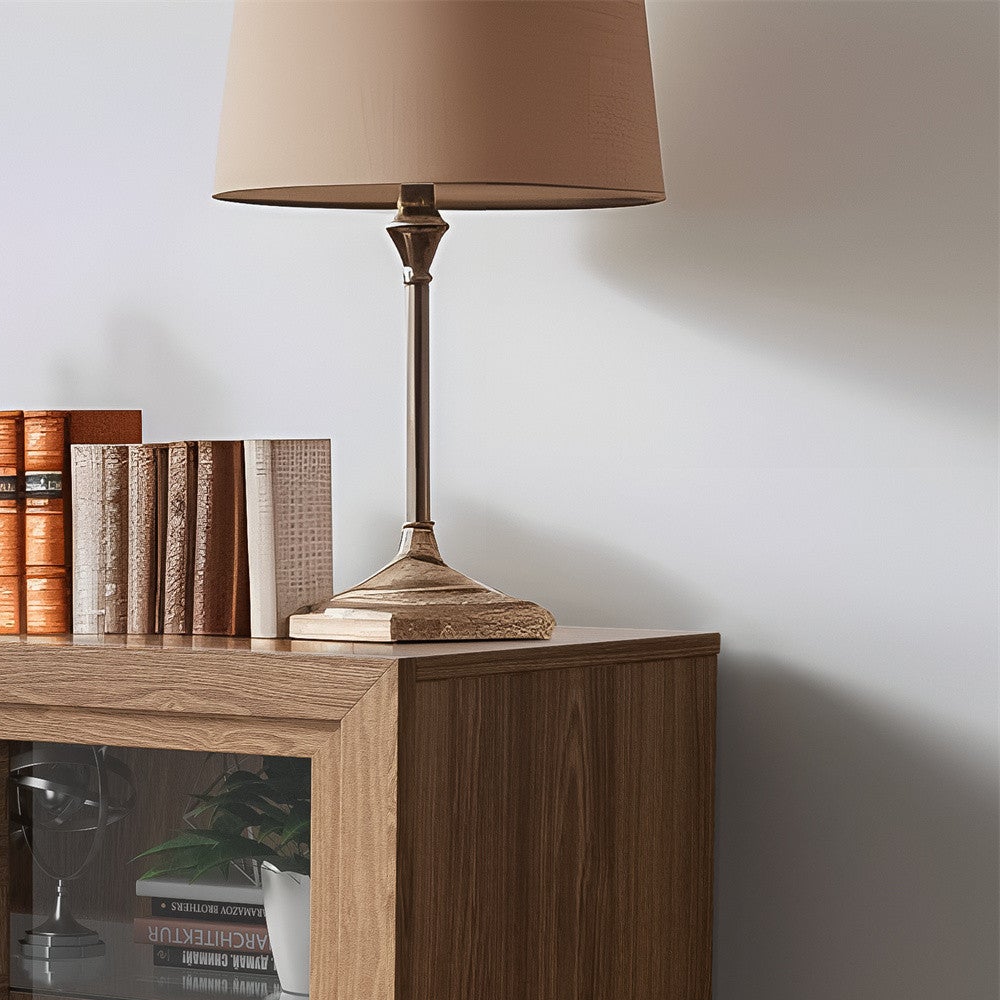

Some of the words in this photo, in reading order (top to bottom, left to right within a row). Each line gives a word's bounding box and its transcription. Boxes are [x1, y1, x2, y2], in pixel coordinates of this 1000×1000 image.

[171, 901, 218, 914] BROTHERS
[148, 926, 268, 951] ARCHITEKTUR
[182, 949, 228, 967] СНИМАЙ!
